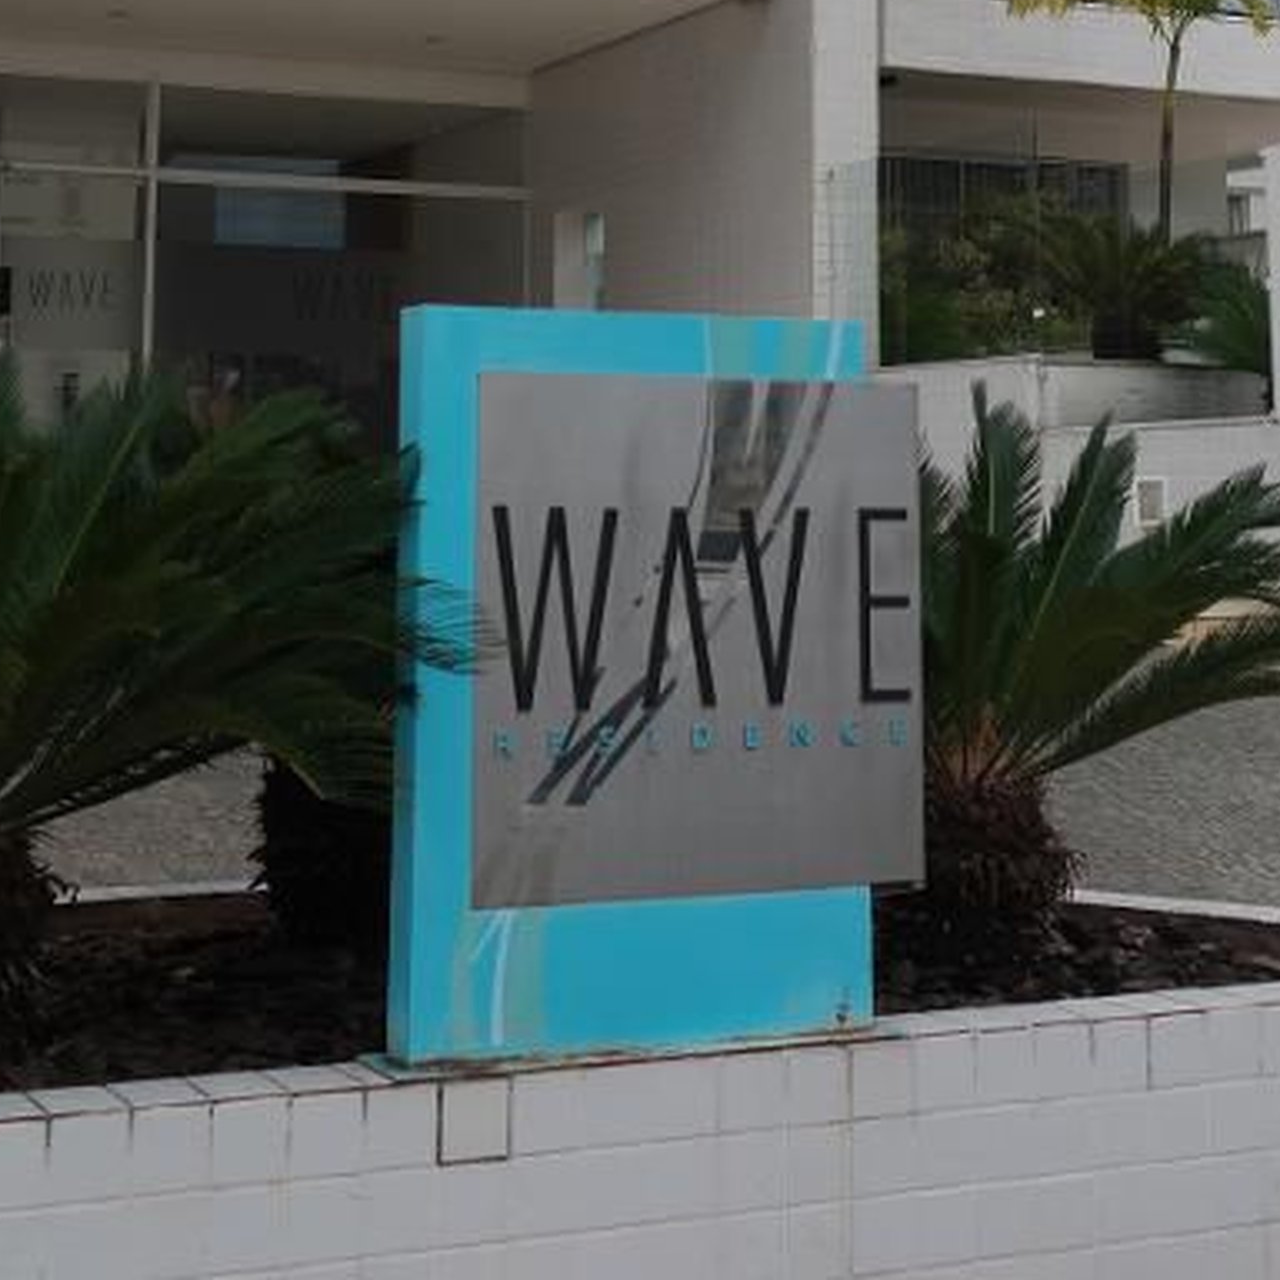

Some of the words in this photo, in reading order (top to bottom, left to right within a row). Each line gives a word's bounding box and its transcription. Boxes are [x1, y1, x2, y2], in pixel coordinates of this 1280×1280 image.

[27, 267, 117, 310] WAVE
[491, 504, 913, 712] WAVE
[493, 722, 908, 759] RESIDENCE
